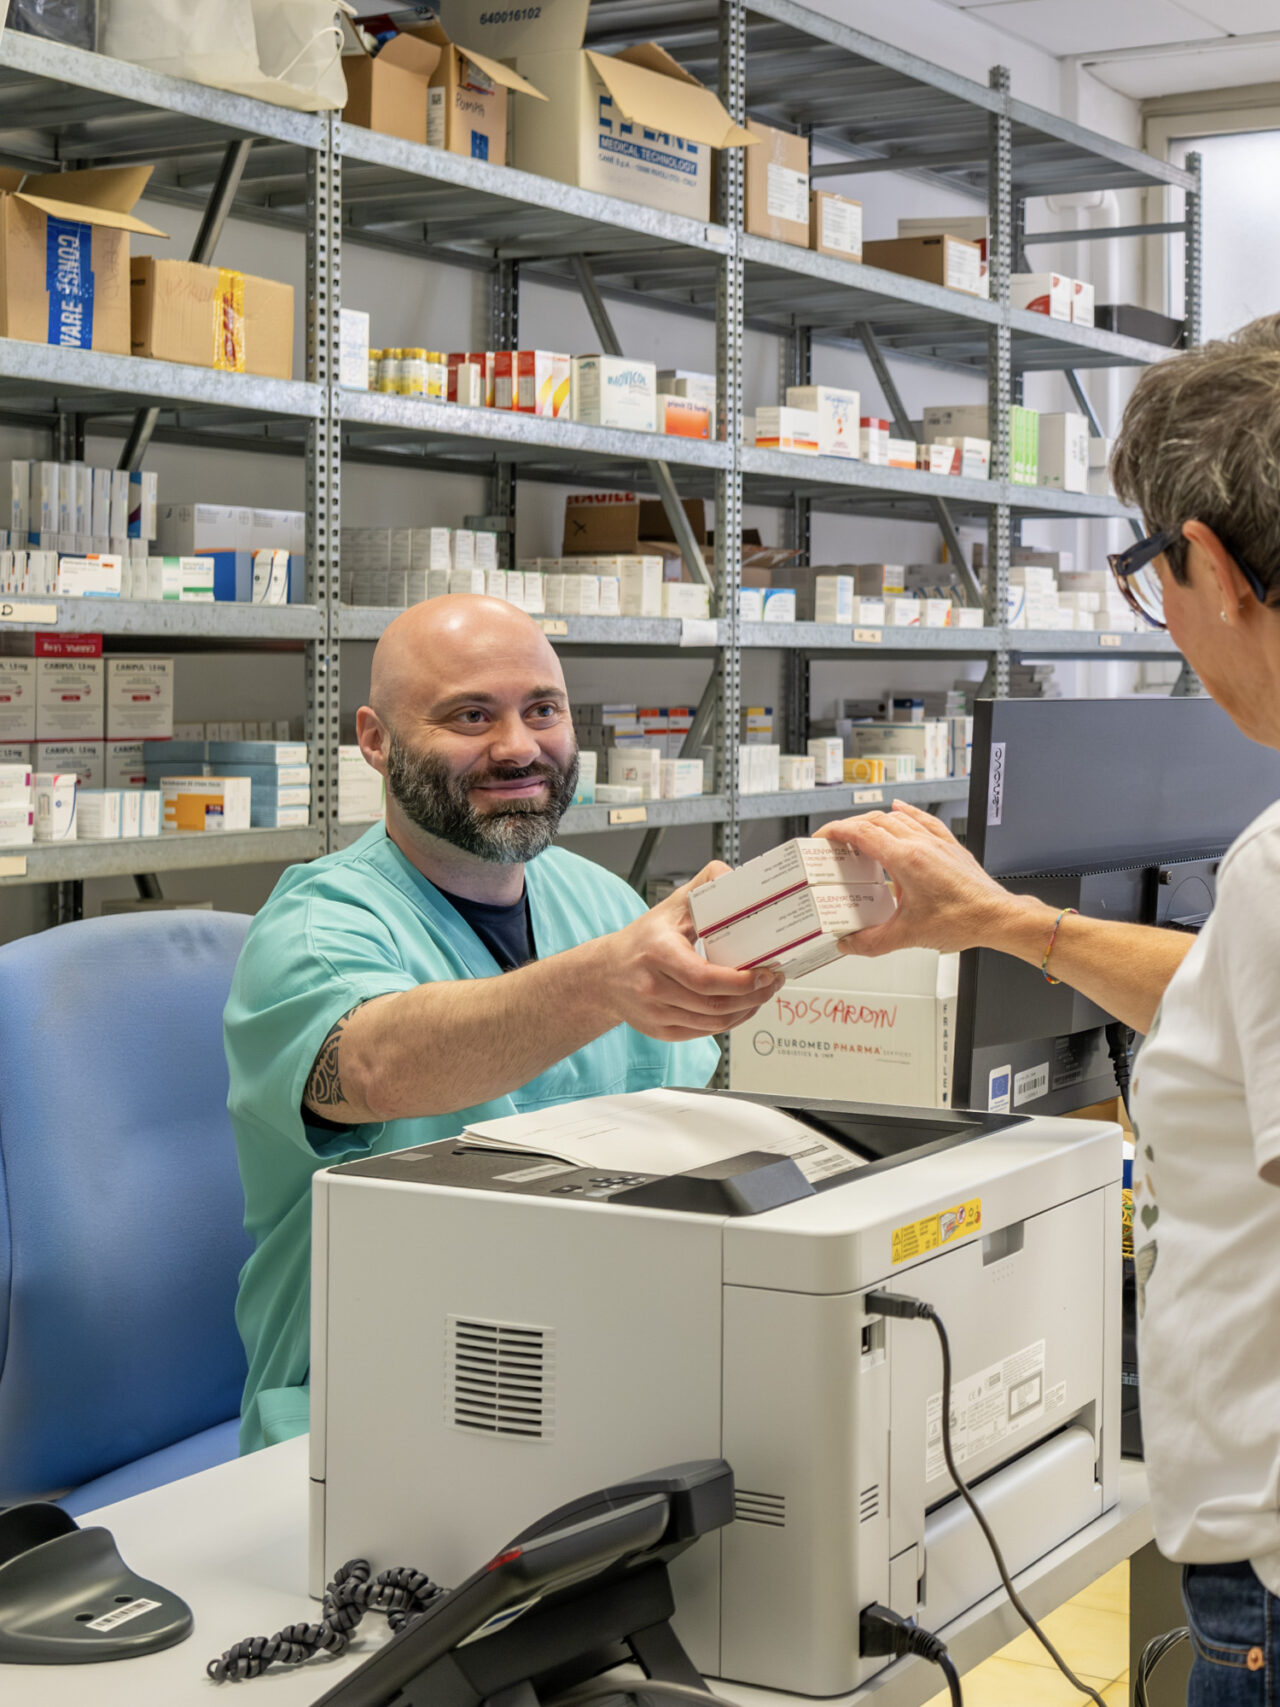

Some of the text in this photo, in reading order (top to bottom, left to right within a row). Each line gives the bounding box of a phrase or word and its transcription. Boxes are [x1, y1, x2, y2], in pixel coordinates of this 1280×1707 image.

[479, 7, 541, 25] 640016102
[600, 136, 697, 174] MEDICAL TECHNOLOGY
[60, 300, 83, 347] VARE
[777, 1038, 831, 1051] EUROMED
[833, 1043, 881, 1055] PHARMA
